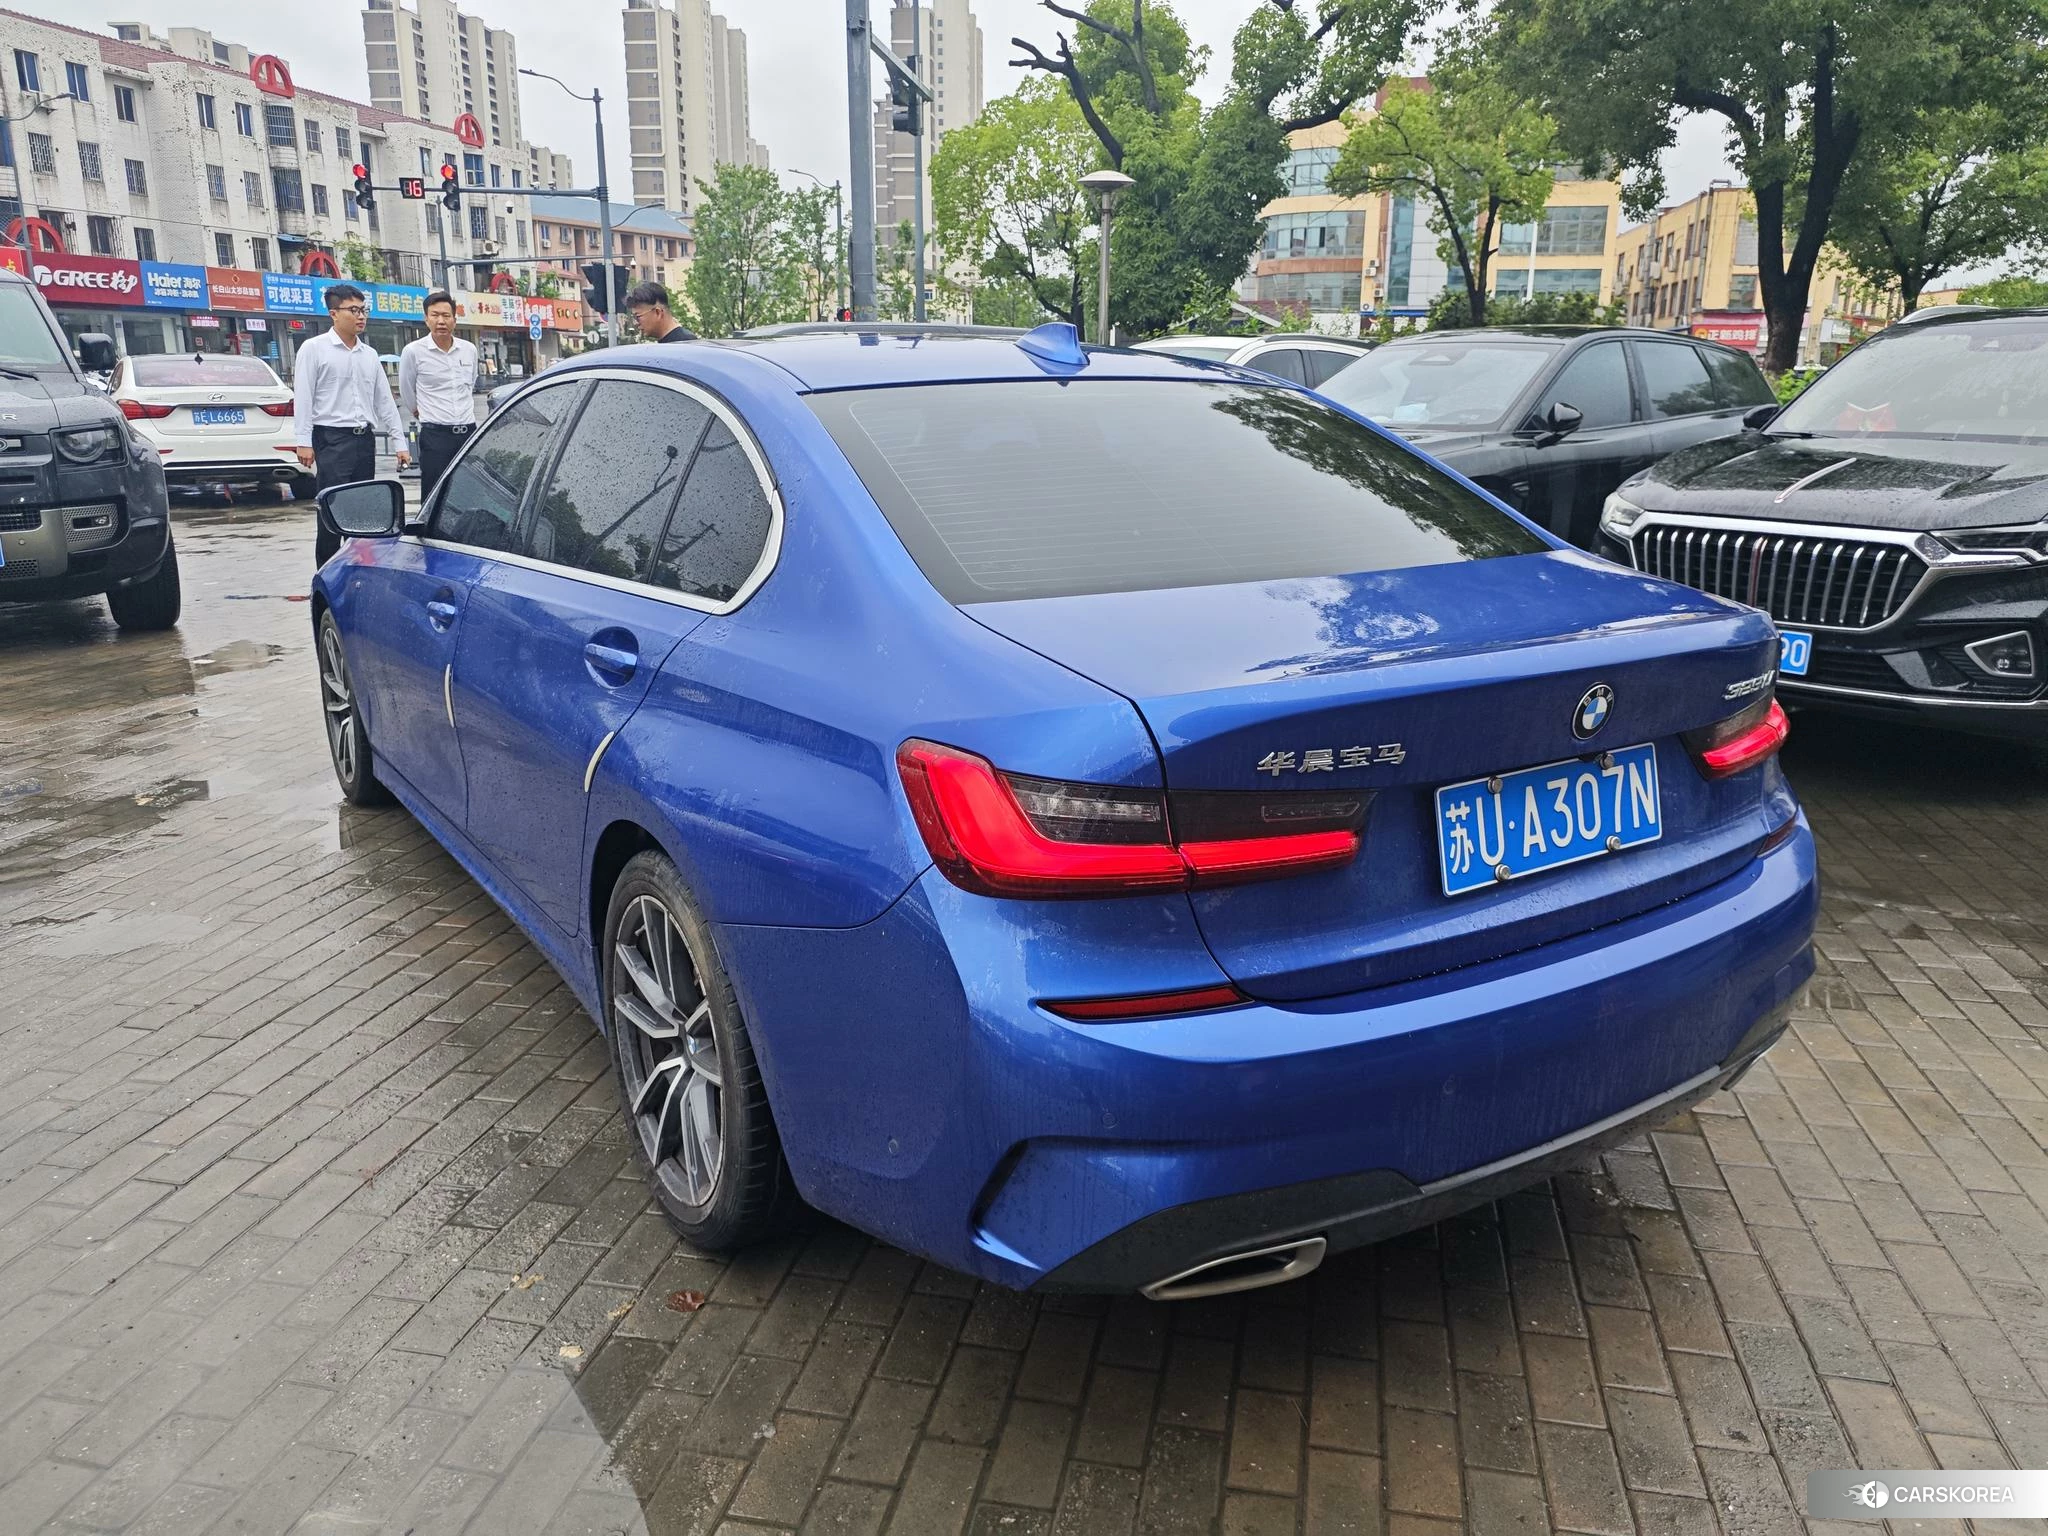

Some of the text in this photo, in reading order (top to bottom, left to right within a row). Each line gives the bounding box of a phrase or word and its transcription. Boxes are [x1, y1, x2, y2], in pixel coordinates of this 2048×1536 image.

[409, 180, 423, 197] 16
[53, 269, 109, 289] GREE
[147, 272, 181, 288] Haier
[267, 286, 314, 305] 可视采耳
[376, 291, 425, 314] 医保定点
[1583, 687, 1613, 706] BMW
[1257, 743, 1406, 776] 华晨宝马
